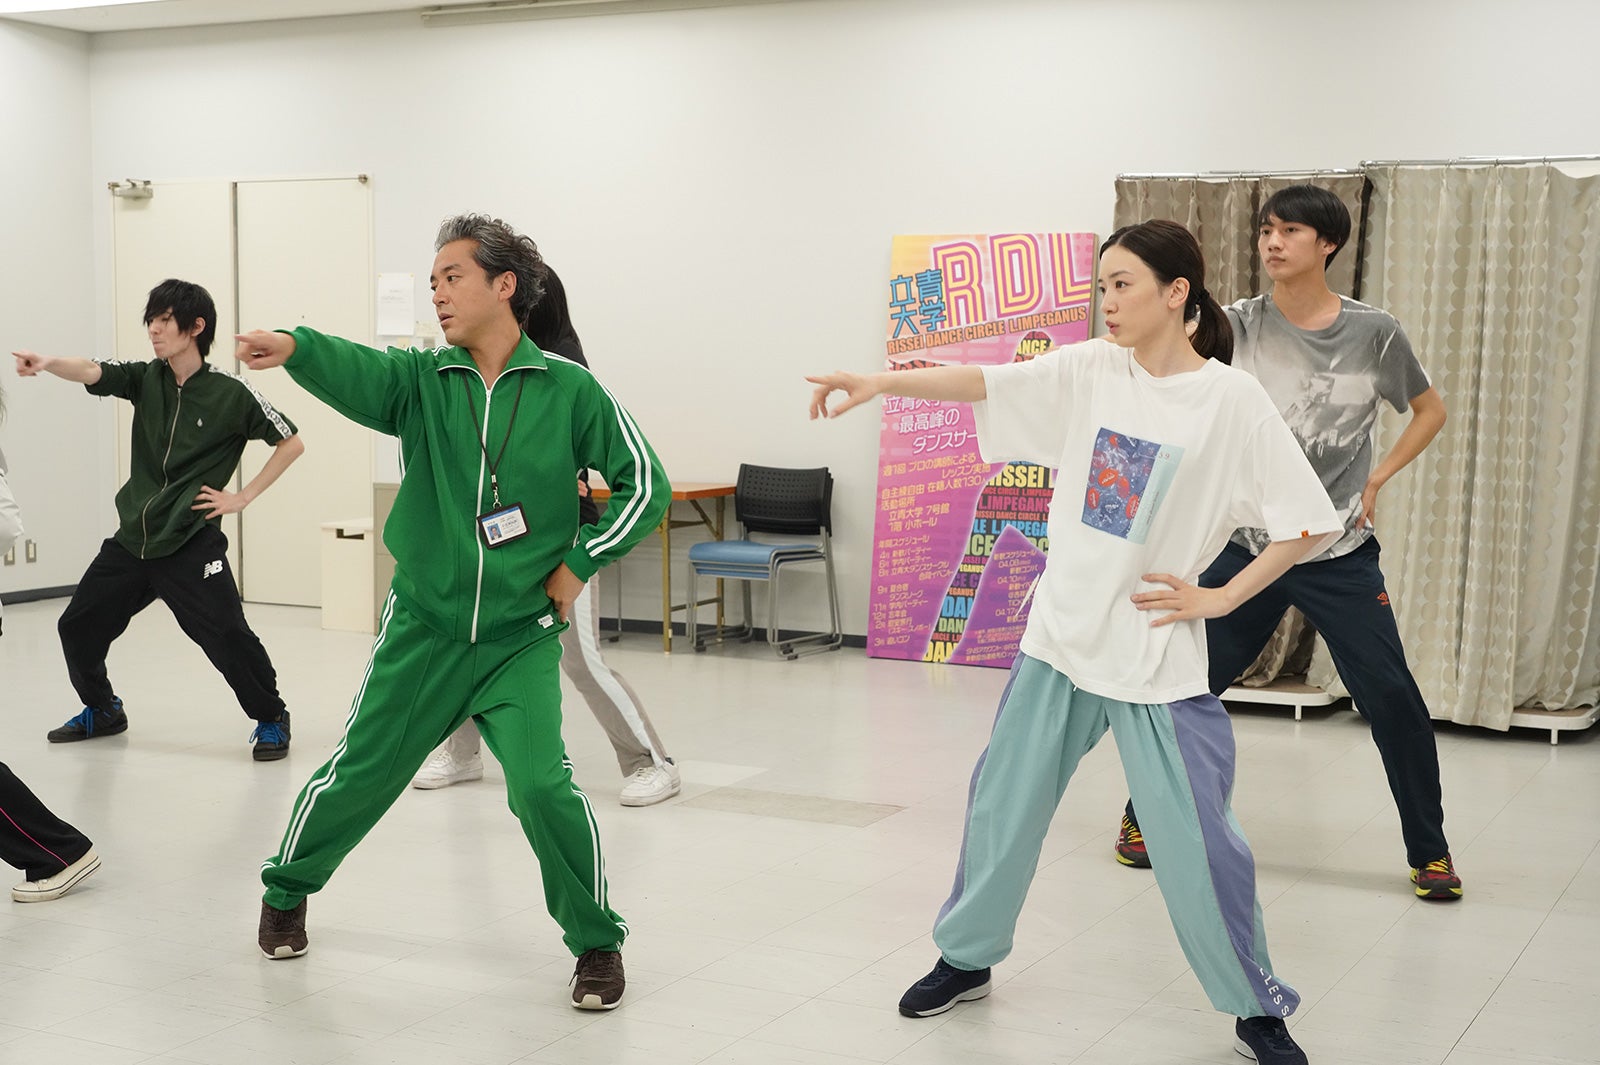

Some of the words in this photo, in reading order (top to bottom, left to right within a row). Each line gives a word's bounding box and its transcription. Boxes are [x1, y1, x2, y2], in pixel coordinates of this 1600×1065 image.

[932, 232, 1091, 329] RDL
[886, 336, 925, 355] RISSEI
[925, 329, 963, 349] DANCE
[964, 320, 1006, 341] CIRCLE
[1008, 306, 1088, 334] L.IMPEGANUS
[899, 408, 960, 434] 最高峰の
